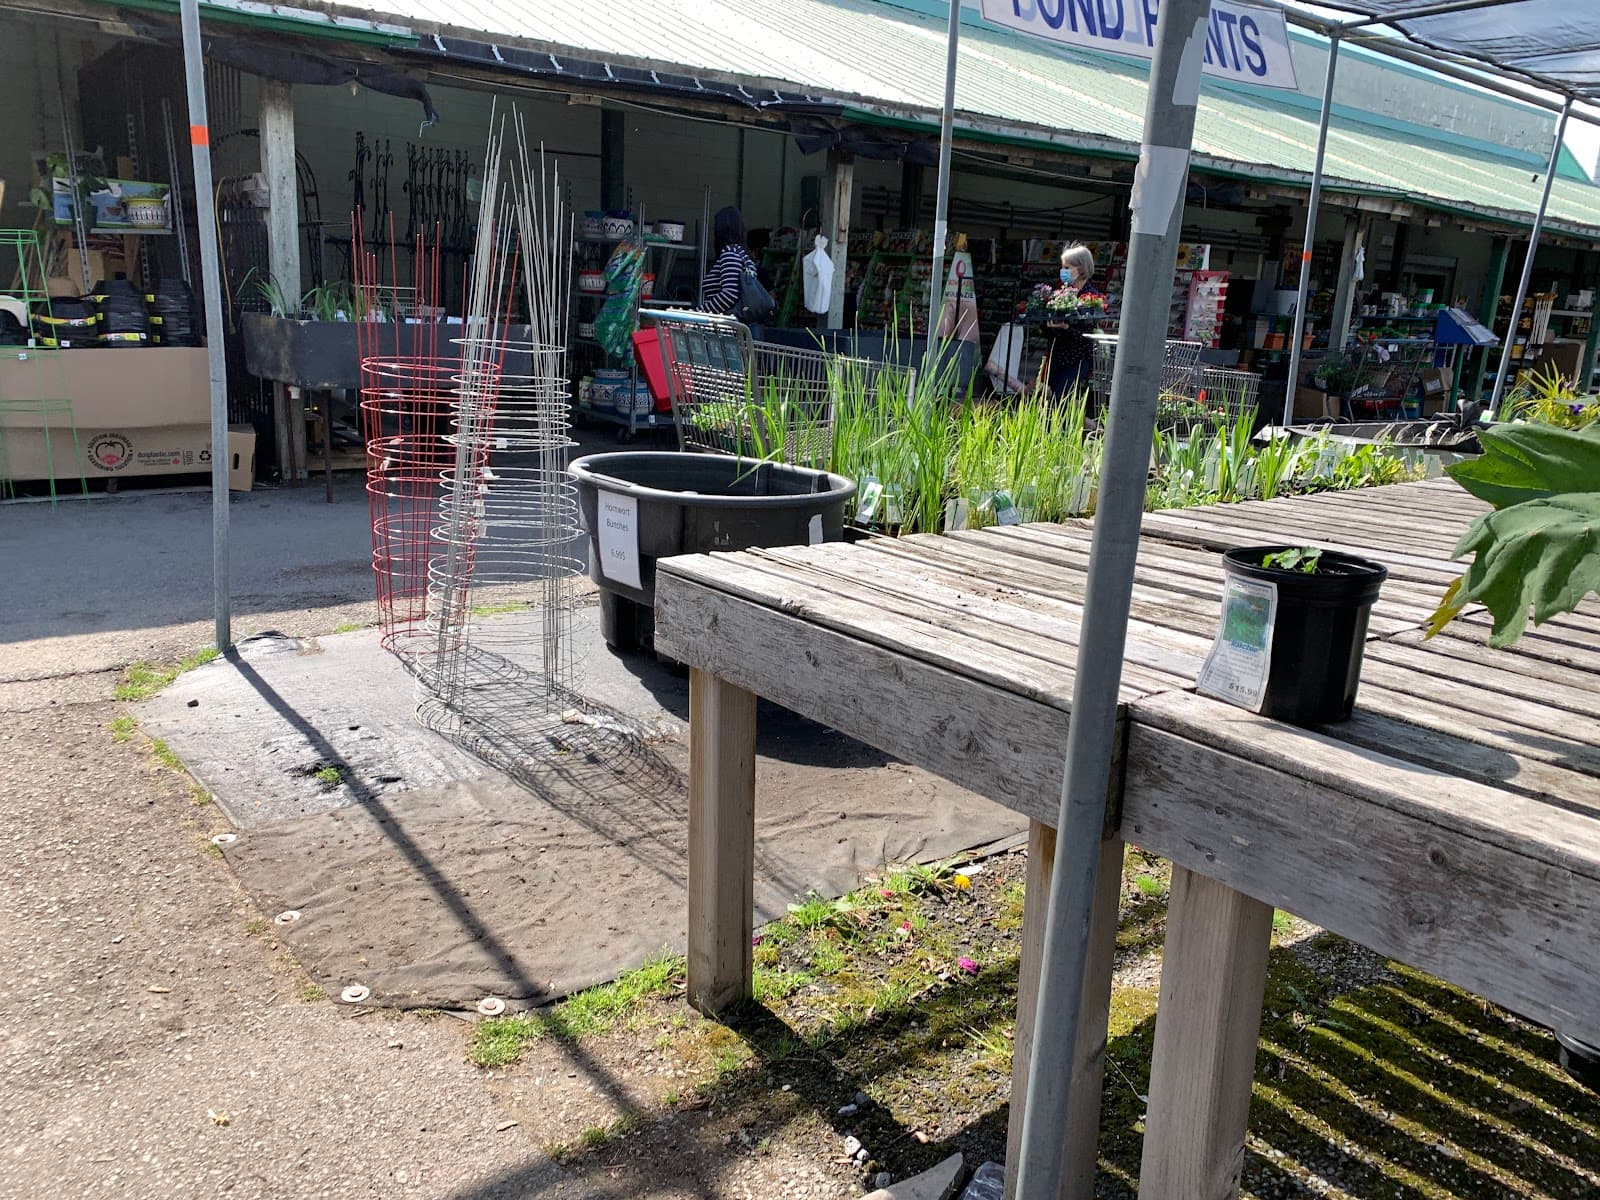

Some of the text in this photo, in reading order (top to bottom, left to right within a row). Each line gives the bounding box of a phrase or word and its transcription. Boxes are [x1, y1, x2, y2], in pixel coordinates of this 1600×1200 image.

[1013, 0, 1267, 76] OND PNTS
[1228, 682, 1258, 697] $15.99
